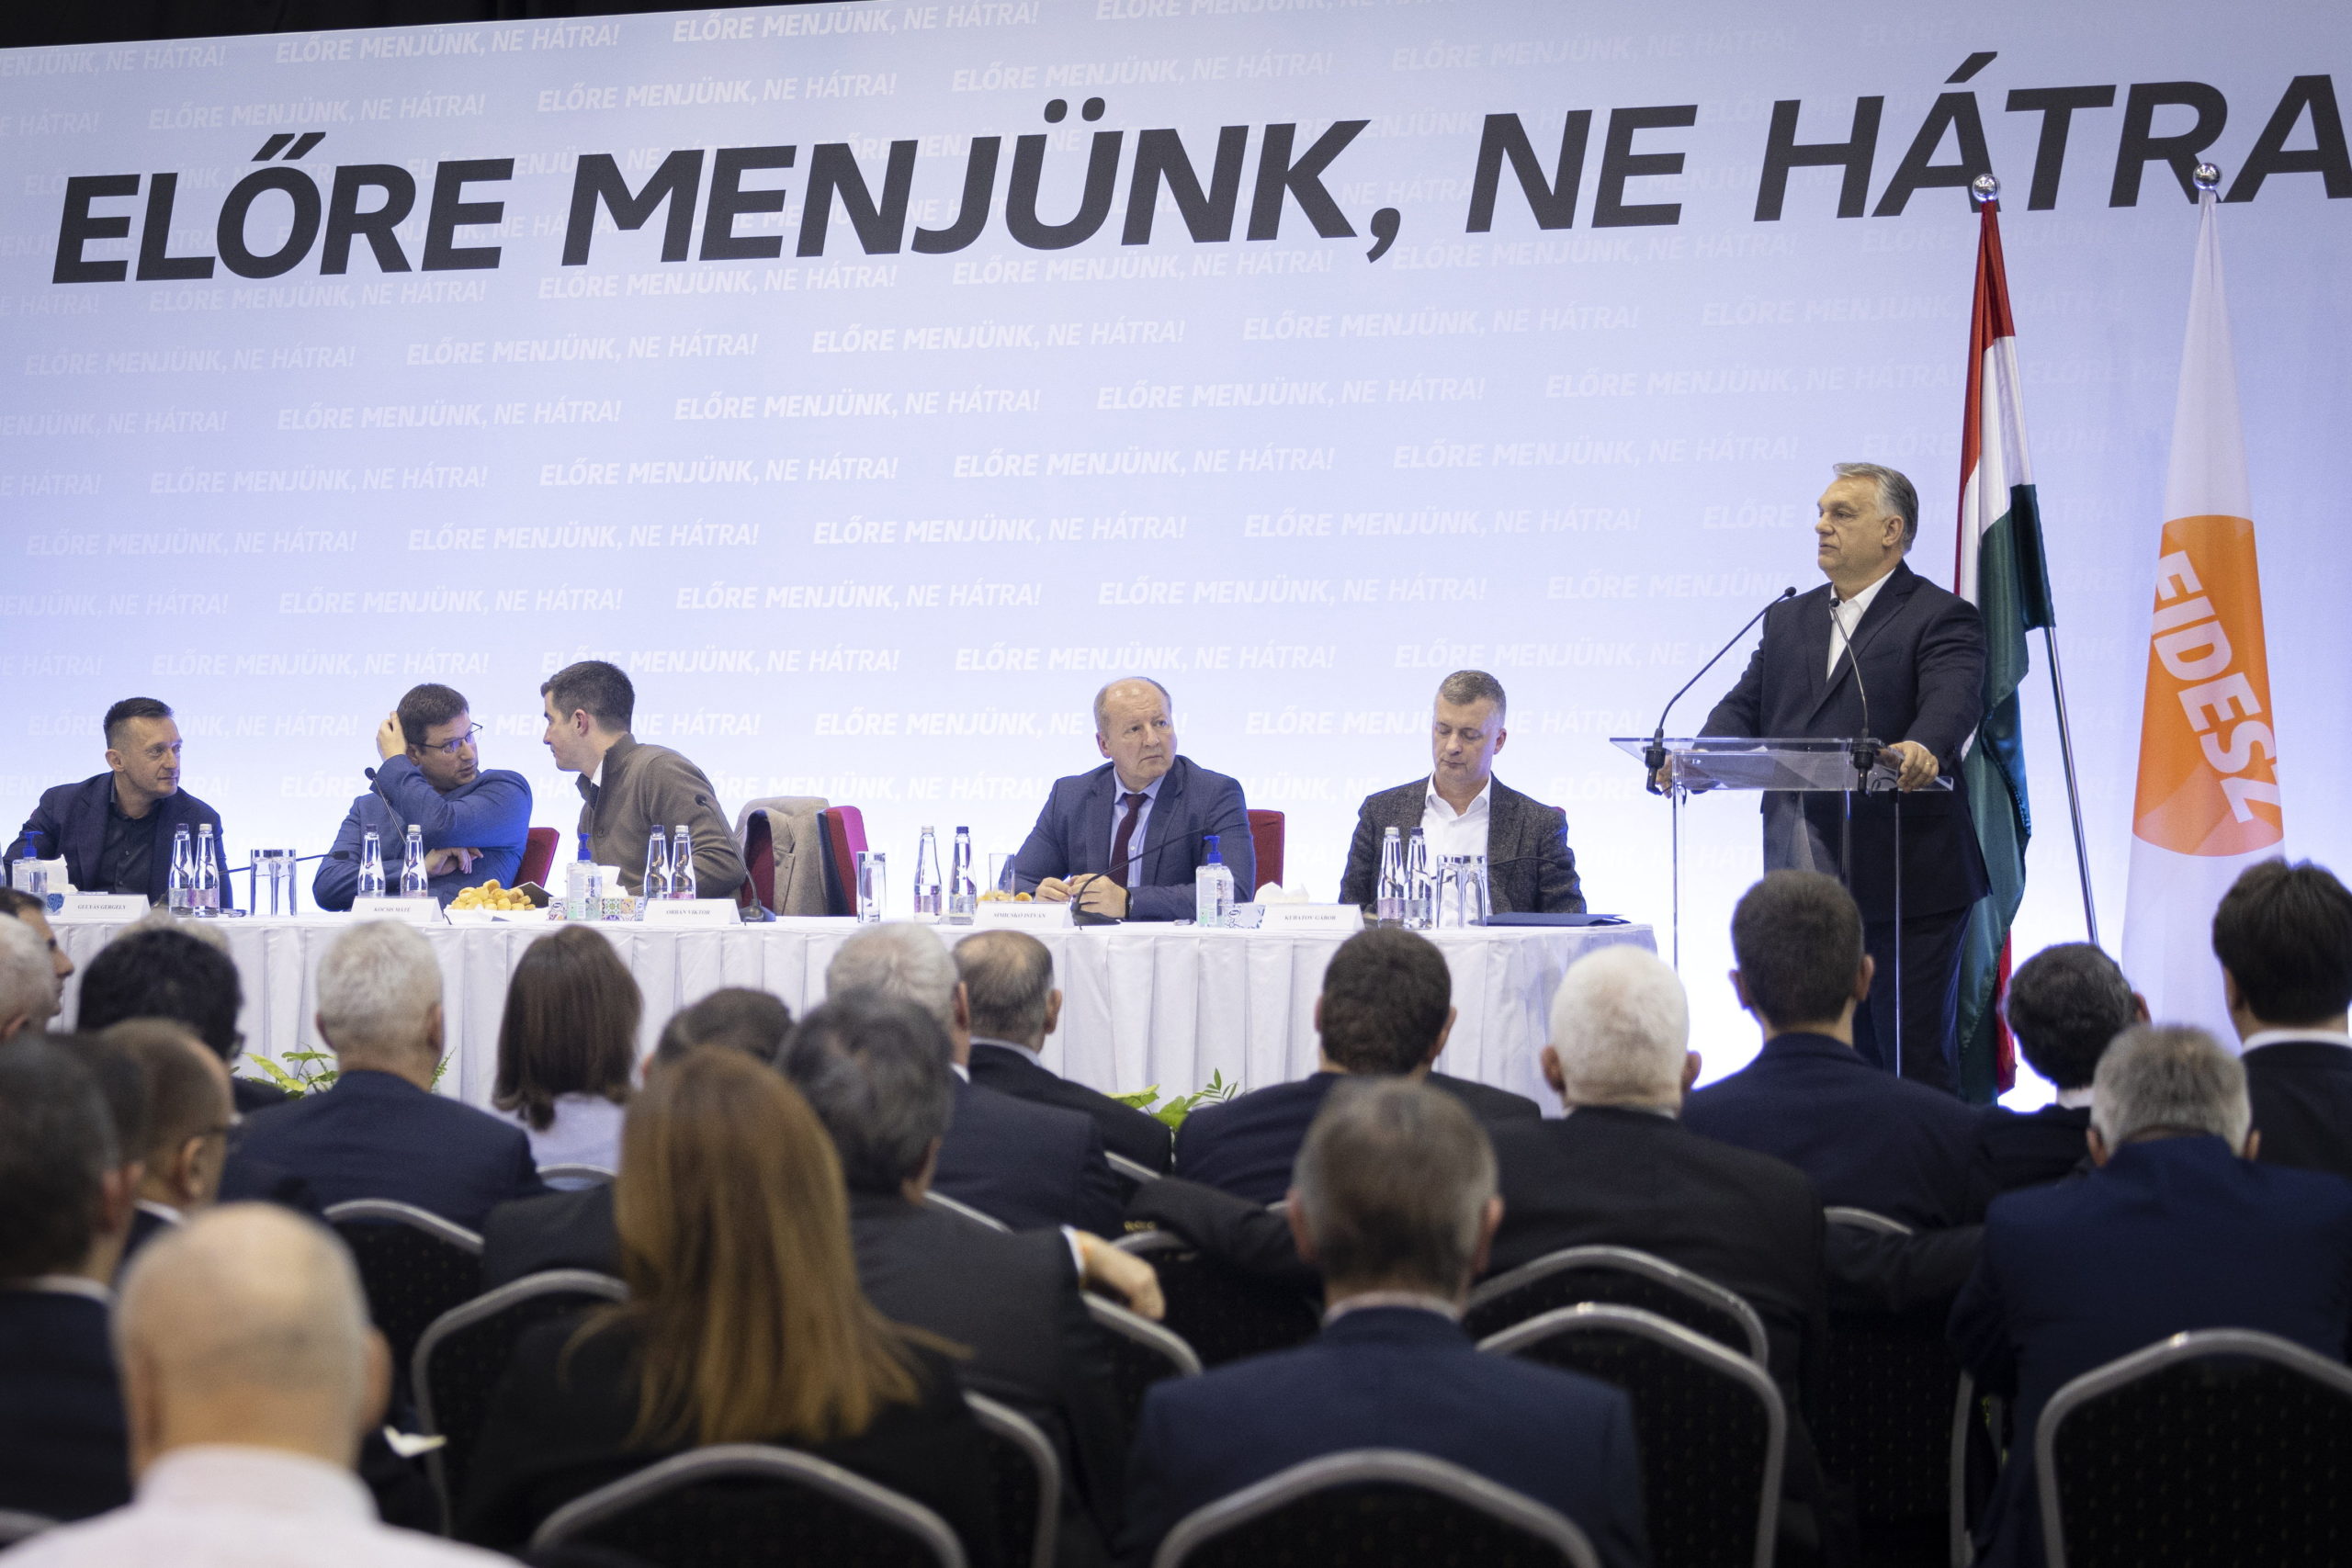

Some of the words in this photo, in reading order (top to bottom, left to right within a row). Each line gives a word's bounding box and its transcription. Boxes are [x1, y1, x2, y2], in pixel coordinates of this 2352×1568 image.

[673, 11, 755, 42] ELŐRE
[762, 4, 897, 38] MENJÜNK,
[902, 6, 939, 30] NE
[944, 0, 1039, 28] HÁTRA!
[275, 33, 354, 63] ELŐRE
[359, 27, 486, 59] MENJÜNK,
[491, 28, 525, 52] NE
[532, 19, 620, 50] HÁTRA!
[1390, 37, 1483, 71] ELŐRE
[0, 48, 100, 80] ENJÜNK,
[105, 49, 137, 72] NE
[142, 41, 226, 71] HÁTRA!
[951, 61, 1038, 93] ELŐRE
[1044, 54, 1185, 88] MENJÜNK,
[1192, 56, 1229, 81] NE
[1236, 47, 1334, 79] HÁTRA!
[537, 81, 618, 112] ELŐRE
[624, 75, 757, 107] MENJÜNK,
[763, 76, 797, 101] NE
[805, 68, 898, 99] HÁTRA!
[18, 107, 100, 137] HÁTRA!
[147, 101, 224, 131] ELŐRE
[230, 96, 355, 127] MENJÜNK,
[360, 96, 393, 120] NE
[399, 88, 486, 118] HÁTRA!
[51, 131, 515, 284] ELŐRE
[561, 96, 1400, 266] MENJÜNK,
[1466, 105, 1698, 232] NE
[1754, 51, 2352, 222] HÁTRA
[537, 270, 619, 300] ELŐRE
[625, 265, 757, 296] MENJÜNK,
[763, 267, 798, 291] NE
[805, 259, 897, 290] HÁTRA!
[951, 254, 1038, 286] ELŐRE
[1191, 253, 1228, 277] NE
[1235, 243, 1334, 275] HÁTRA!
[148, 284, 225, 314] ELŐRE
[360, 282, 394, 305] NE
[400, 276, 487, 305] HÁTRA!
[810, 322, 896, 354] ELŐRE
[902, 319, 1040, 351] MENJÜNK,
[1046, 321, 1082, 346] NE
[1090, 314, 1185, 345] HÁTRA!
[1241, 309, 1332, 340] ELŐRE
[1492, 308, 1531, 333] NE
[1538, 299, 1641, 332] HÁTRA!
[232, 347, 265, 371] NE
[270, 341, 356, 369] HÁTRA!
[405, 335, 486, 366] ELŐRE
[492, 333, 621, 363] MENJÜNK,
[627, 335, 662, 359] NE
[667, 328, 758, 357] HÁTRA!
[1095, 378, 1184, 410] ELŐRE
[1191, 375, 1334, 408] MENJÜNK,
[1340, 378, 1379, 403] NE
[1385, 371, 1487, 402] HÁTRA!
[1544, 366, 1638, 399] ELŐRE
[277, 401, 355, 431] ELŐRE
[360, 399, 488, 429] MENJÜNK,
[493, 401, 527, 425] NE
[533, 394, 622, 424] HÁTRA!
[673, 390, 757, 421] ELŐRE
[763, 388, 898, 419] MENJÜNK,
[904, 390, 940, 414] NE
[946, 383, 1041, 413] HÁTRA!
[0, 409, 101, 439] ENJÜNK,
[107, 412, 139, 434] NE
[144, 405, 228, 434] HÁTRA!
[538, 457, 621, 486] ELŐRE
[627, 454, 759, 486] MENJÜNK,
[764, 457, 800, 481] NE
[807, 450, 899, 480] HÁTRA!
[953, 446, 1039, 478] ELŐRE
[1046, 445, 1186, 477] MENJÜNK,
[1193, 448, 1230, 473] NE
[1237, 441, 1335, 472] HÁTRA!
[1393, 437, 1485, 468] ELŐRE
[19, 468, 102, 497] HÁTRA!
[150, 466, 227, 494] ELŐRE
[362, 467, 395, 490] NE
[401, 460, 489, 490] HÁTRA!
[407, 522, 487, 551] ELŐRE
[492, 520, 623, 551] MENJÜNK,
[628, 524, 663, 547] NE
[669, 517, 760, 547] HÁTRA!
[812, 514, 898, 544] ELŐRE
[903, 513, 1042, 545] MENJÜNK,
[1047, 516, 1084, 540] NE
[1091, 509, 1187, 540] HÁTRA!
[1243, 506, 1334, 537] ELŐRE
[1494, 509, 1532, 533] NE
[25, 528, 101, 557] ELŐRE
[233, 531, 266, 554] NE
[272, 524, 357, 553] HÁTRA!
[145, 587, 230, 615] HÁTRA!
[277, 585, 356, 614] ELŐRE
[494, 589, 529, 612] NE
[535, 581, 624, 611] HÁTRA!
[675, 580, 759, 610] ELŐRE
[764, 579, 899, 611] MENJÜNK,
[905, 583, 942, 607] NE
[948, 576, 1042, 606] HÁTRA!
[1097, 575, 1186, 605] ELŐRE
[1342, 579, 1380, 603] NE
[1387, 570, 1487, 601] HÁTRA!
[364, 652, 397, 674] NE
[402, 646, 490, 674] HÁTRA!
[628, 644, 761, 675] MENJÜNK,
[766, 649, 801, 671] NE
[808, 643, 900, 672] HÁTRA!
[954, 641, 1041, 671] ELŐRE
[1047, 639, 1188, 672] MENJÜNK,
[1194, 646, 1231, 670] NE
[1238, 637, 1337, 669] HÁTRA!
[2151, 550, 2281, 823] FIDESZ
[671, 706, 762, 736] HÁTRA!
[814, 706, 899, 736] ELŐRE
[1049, 712, 1086, 736] NE
[1245, 705, 1335, 735] ELŐRE
